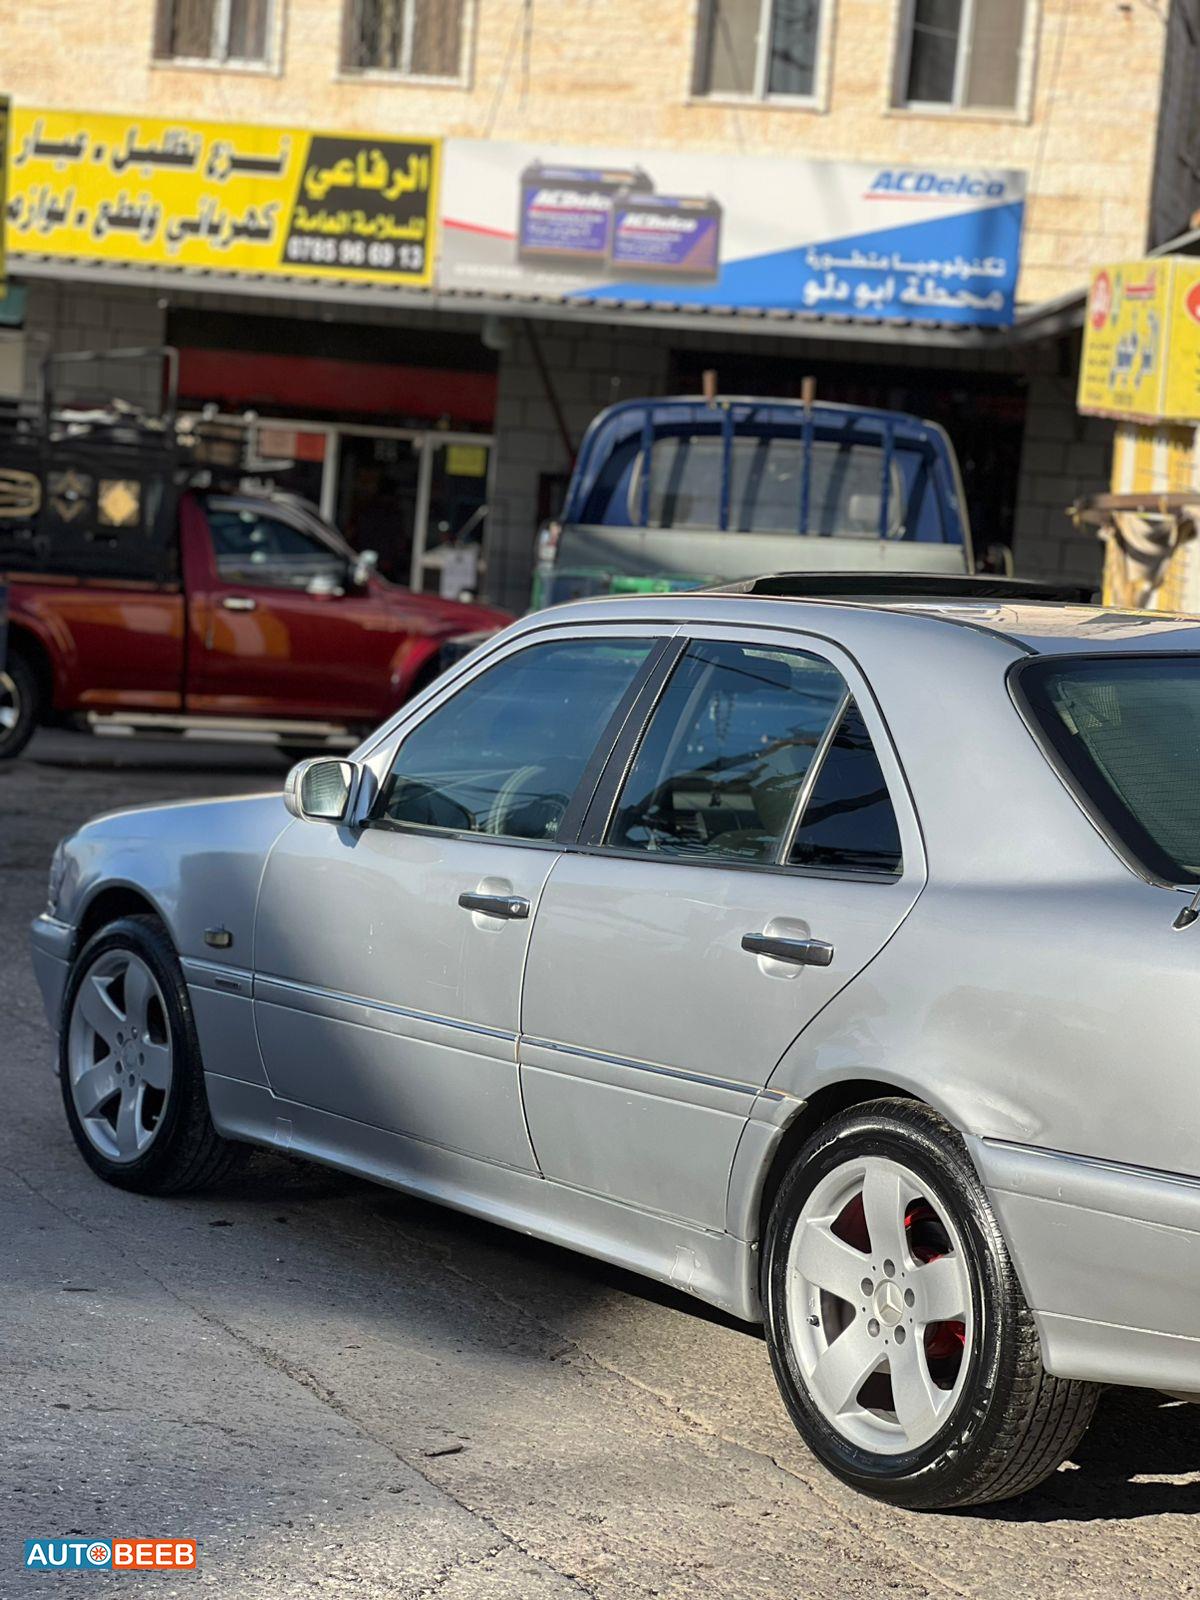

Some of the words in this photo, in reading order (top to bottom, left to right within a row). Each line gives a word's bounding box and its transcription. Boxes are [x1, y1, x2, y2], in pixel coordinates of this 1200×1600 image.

[304, 148, 429, 201] الرفاعي
[871, 171, 1006, 198] ACDelco
[805, 246, 890, 272] متطورة
[892, 251, 1007, 281] تكنولوجيا
[899, 276, 1005, 311] محطة
